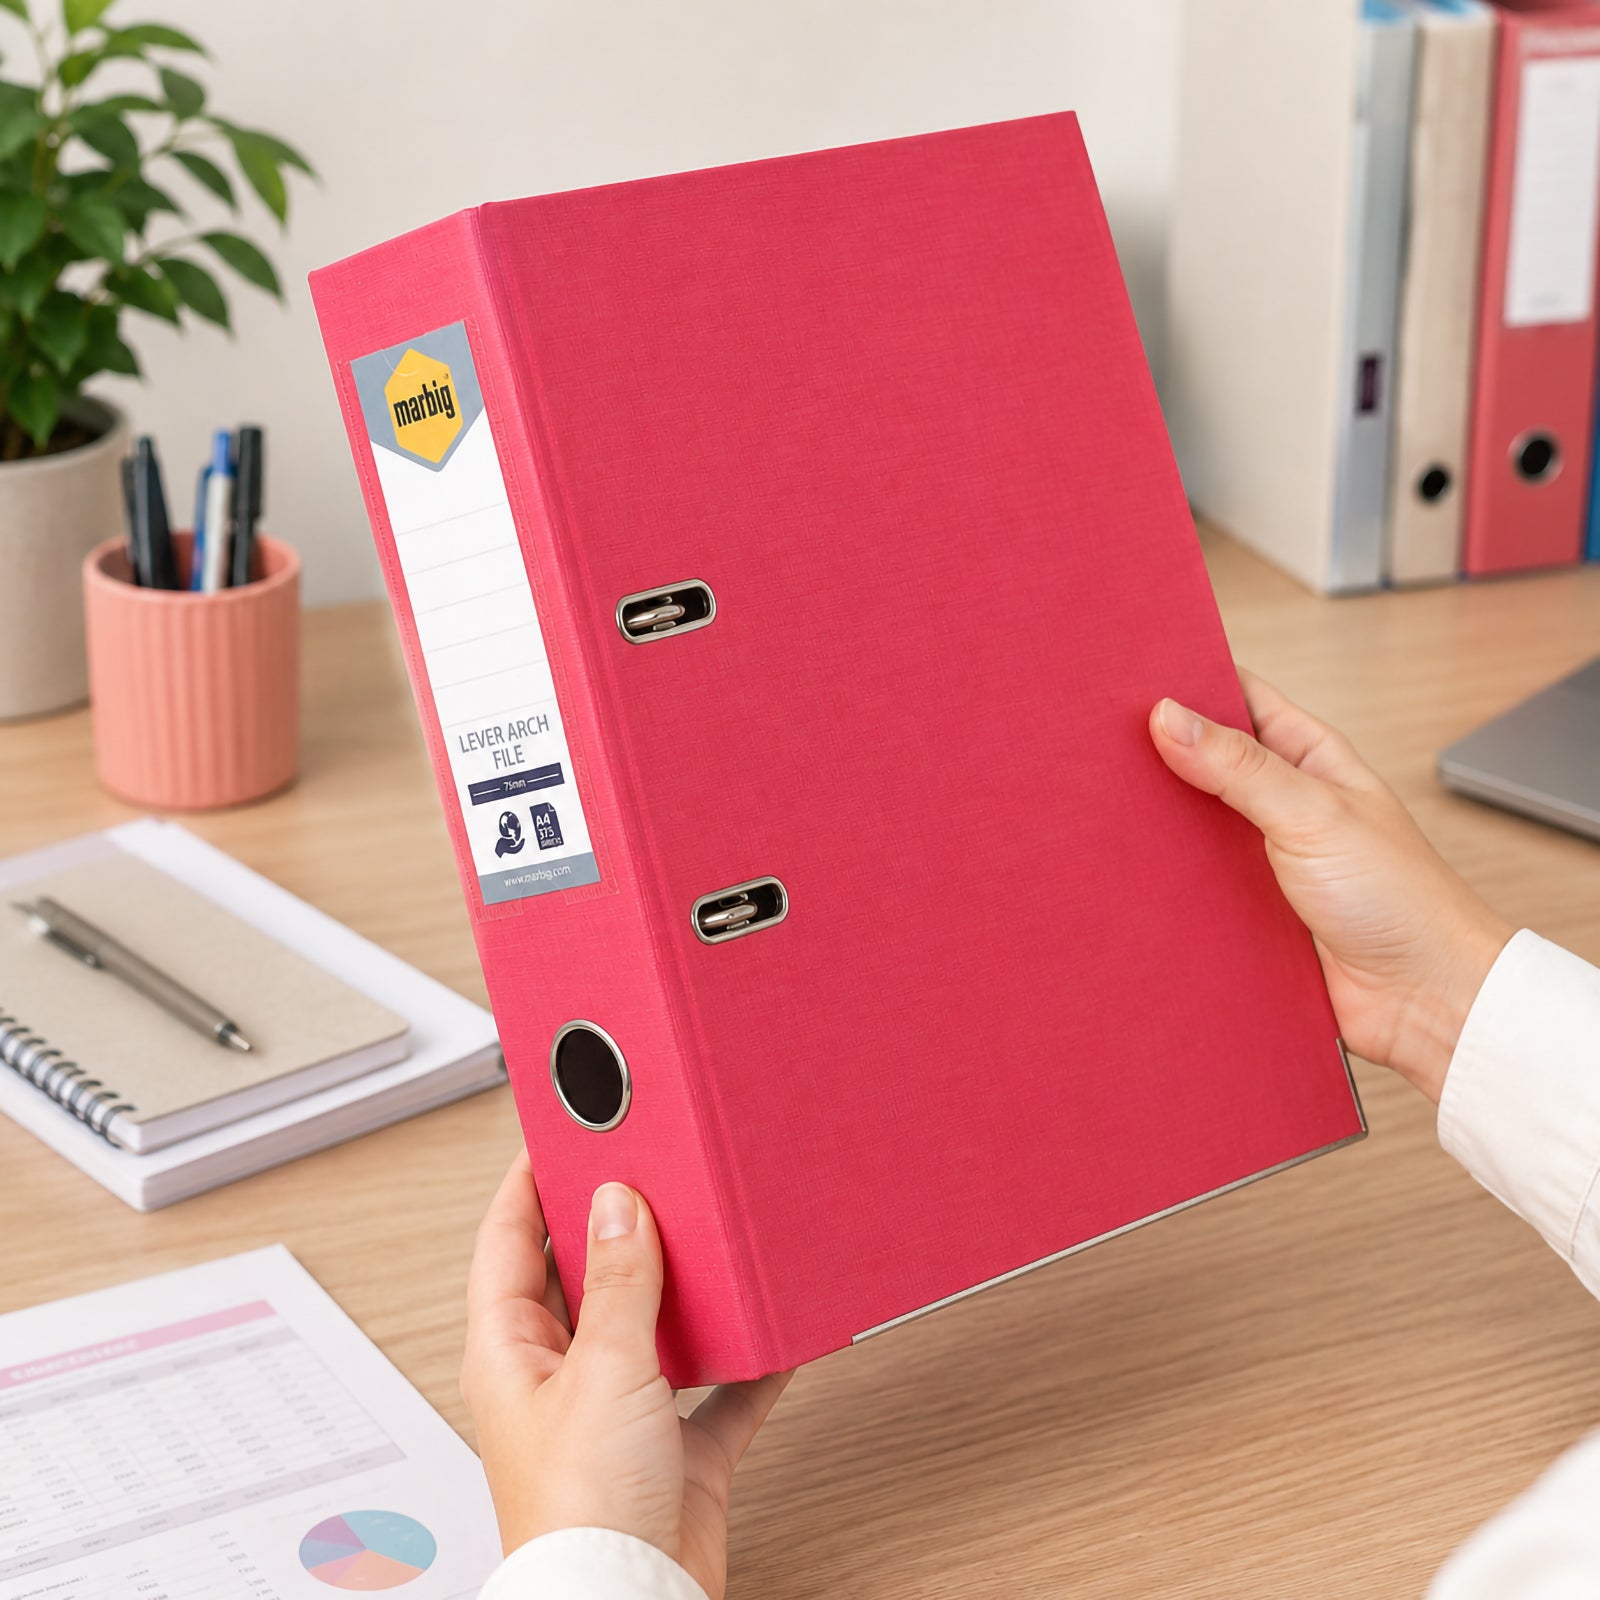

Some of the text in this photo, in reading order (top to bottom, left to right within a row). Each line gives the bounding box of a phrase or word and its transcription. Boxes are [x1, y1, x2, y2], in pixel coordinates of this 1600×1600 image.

[393, 379, 456, 428] marbig
[458, 713, 550, 753] LEVER ARCH
[492, 744, 526, 770] FILE
